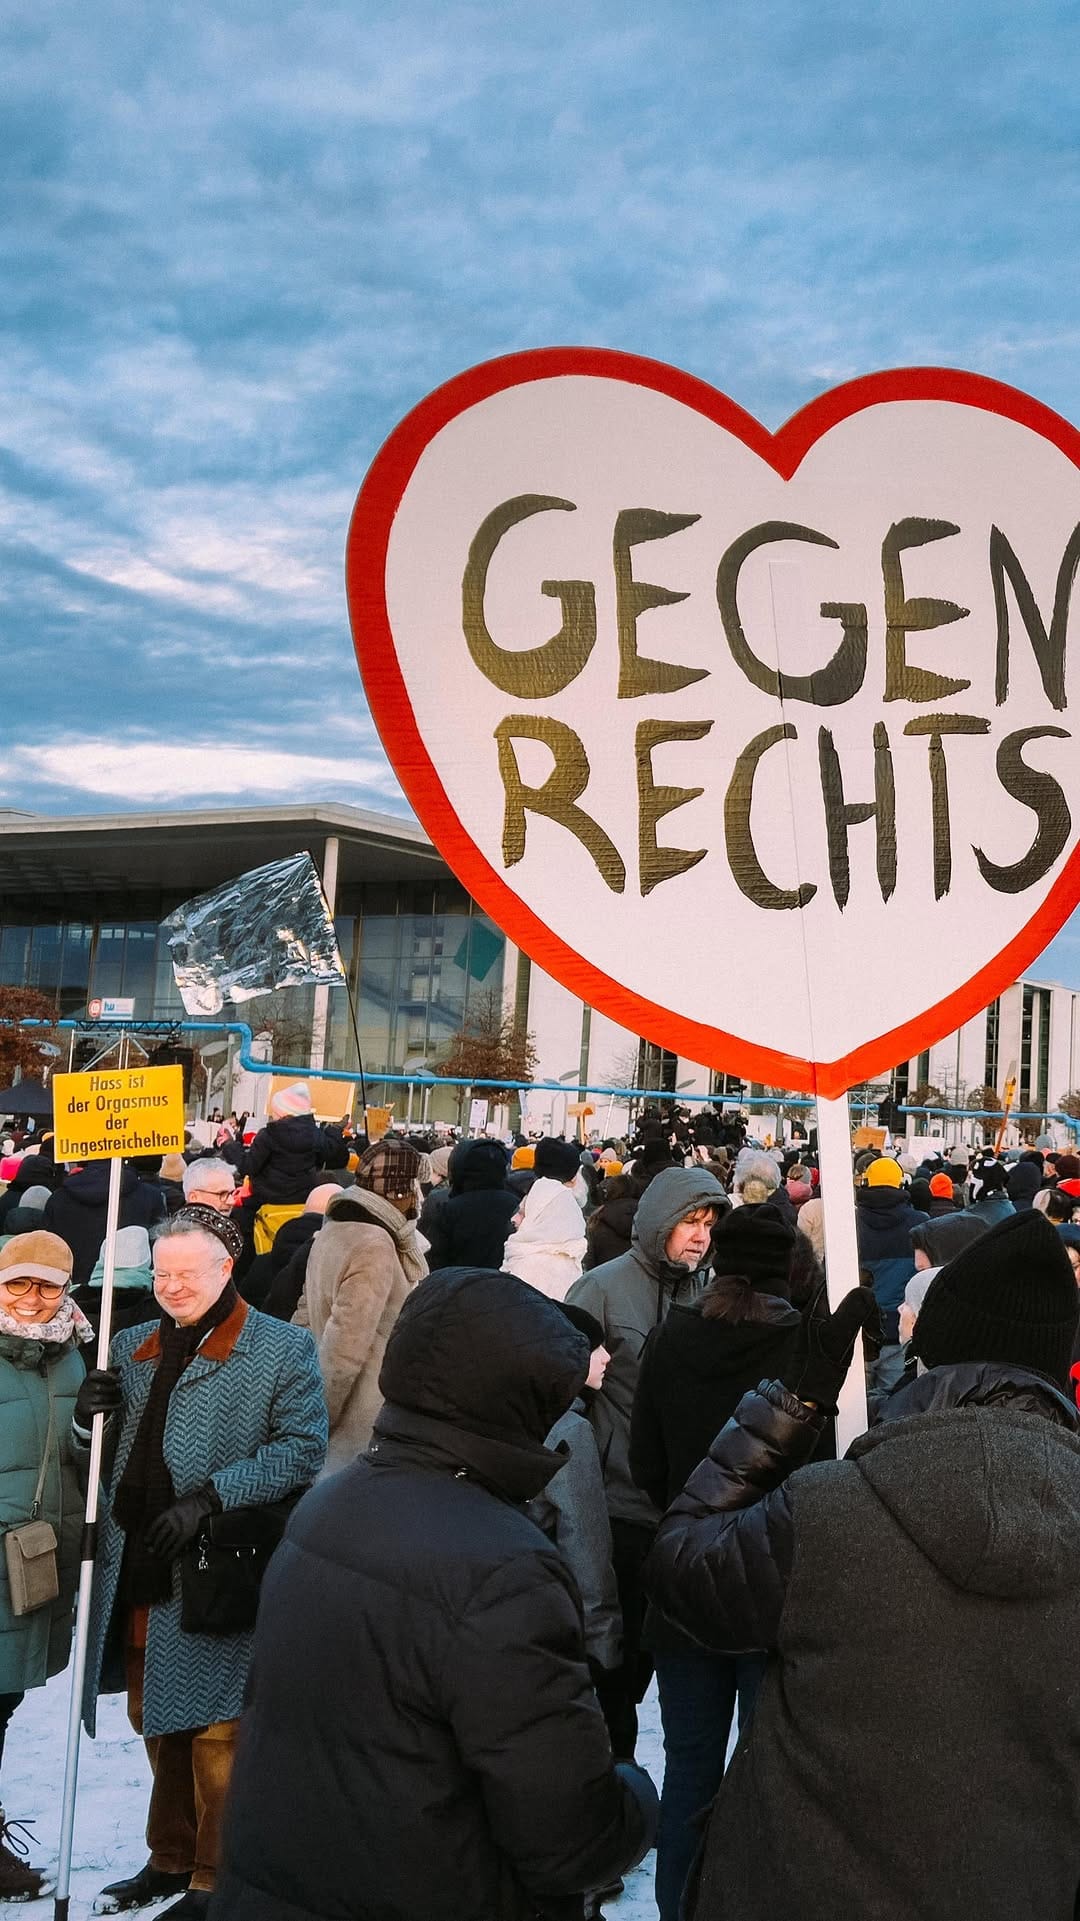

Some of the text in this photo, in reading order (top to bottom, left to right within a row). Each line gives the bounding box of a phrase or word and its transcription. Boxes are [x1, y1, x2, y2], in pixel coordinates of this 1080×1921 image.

[462, 494, 1080, 711] GEGEN
[494, 714, 1071, 914] RECHTS
[90, 1074, 144, 1092] Hass ist
[68, 1095, 168, 1113] der Orgasmus
[105, 1113, 129, 1130] der
[60, 1130, 179, 1157] Ungestreichelten
